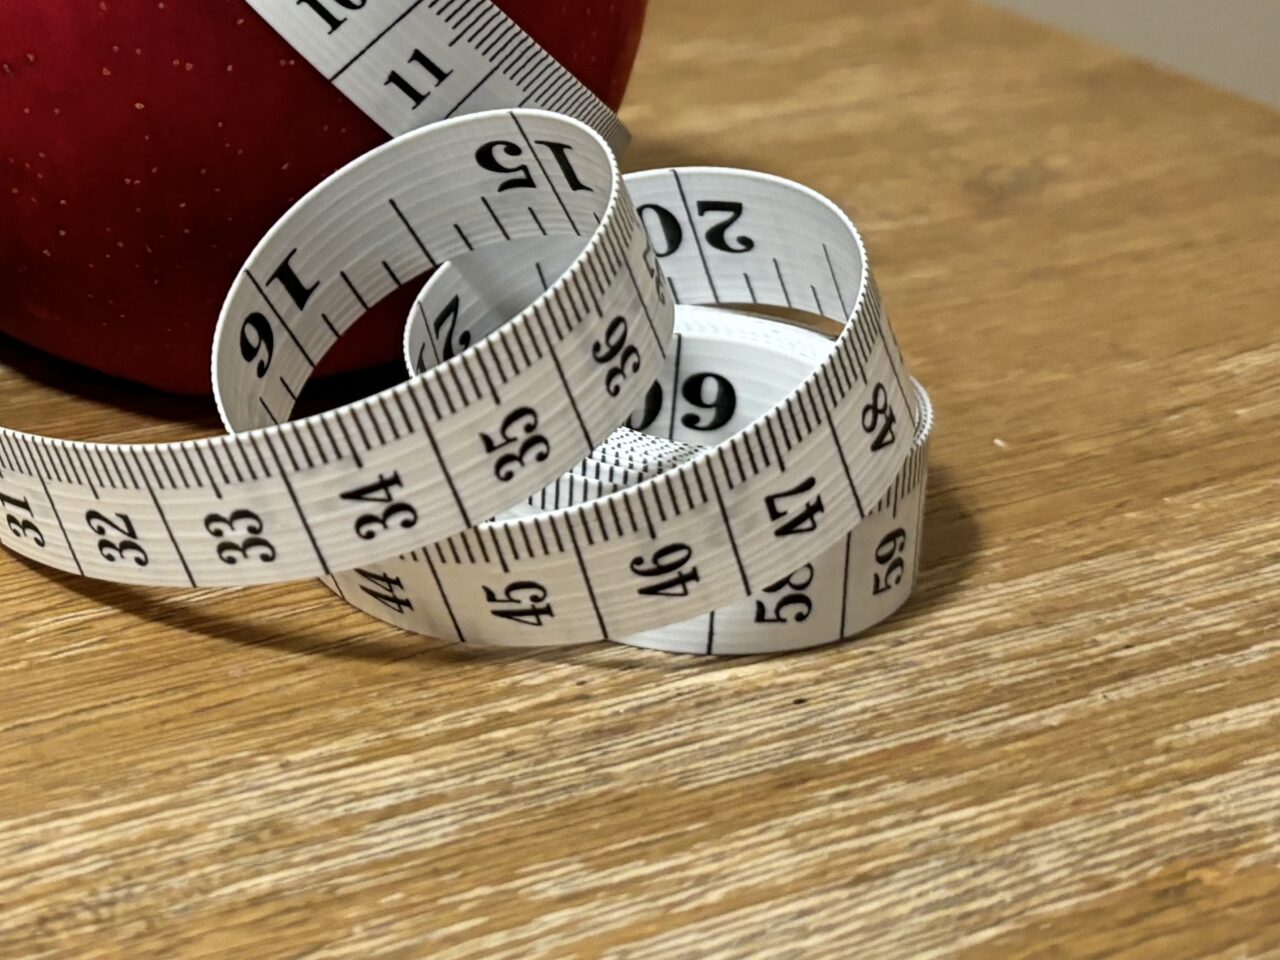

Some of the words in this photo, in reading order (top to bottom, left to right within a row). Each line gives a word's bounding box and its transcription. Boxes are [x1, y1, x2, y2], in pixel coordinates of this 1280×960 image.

[383, 48, 454, 110] 11
[475, 140, 594, 192] 15
[239, 248, 320, 378] 16
[592, 315, 641, 397] 36
[479, 406, 550, 482] 35
[861, 382, 896, 452] 48
[339, 470, 418, 540] 34
[764, 476, 825, 537] 47
[85, 509, 148, 567] 32
[204, 509, 276, 565] 33
[873, 527, 906, 596] 59
[354, 568, 414, 614] 44
[630, 543, 700, 597] 46
[482, 581, 555, 626] 45
